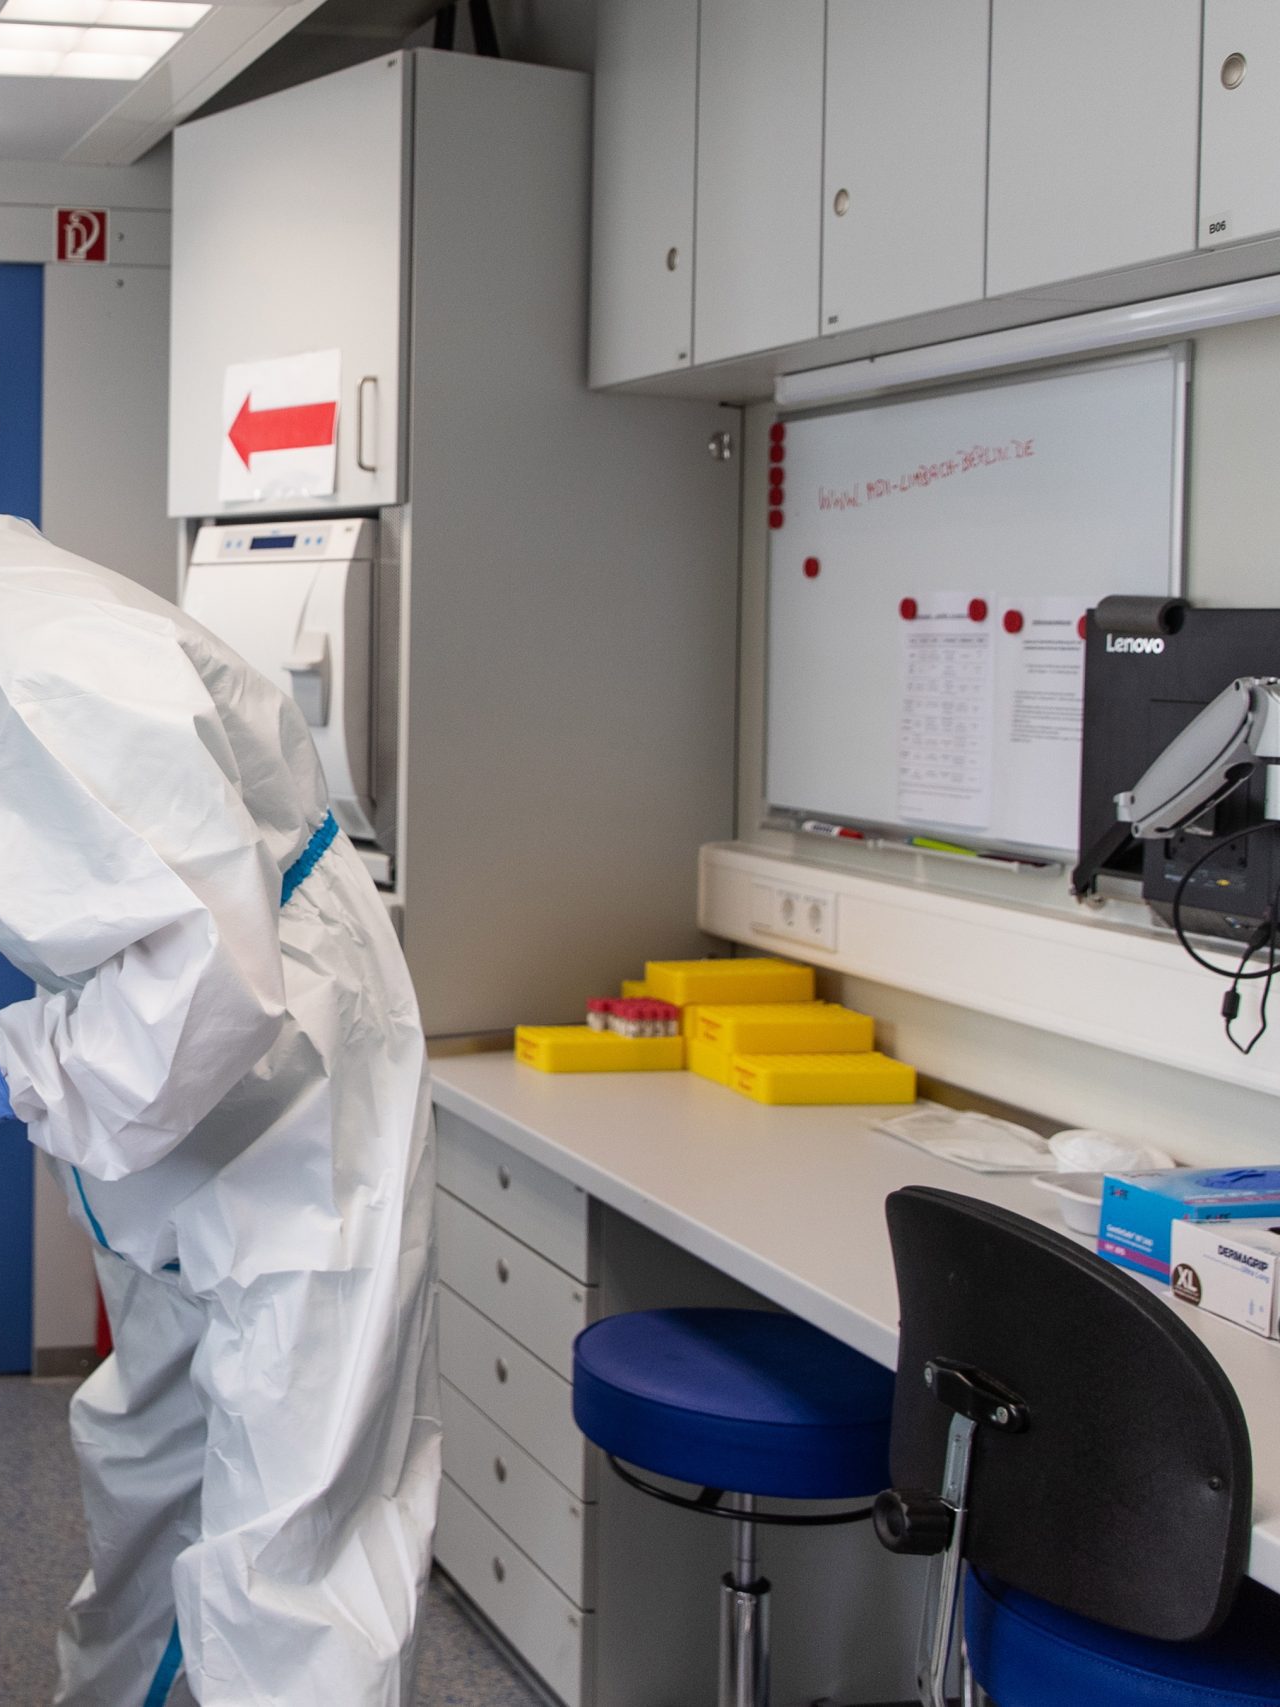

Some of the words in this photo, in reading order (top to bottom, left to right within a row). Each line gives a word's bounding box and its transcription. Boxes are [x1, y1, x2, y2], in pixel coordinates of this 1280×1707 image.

[1209, 220, 1227, 234] B06
[1106, 633, 1165, 654] Lenovo
[1218, 1245, 1269, 1271] DERMAGRIP
[1176, 1265, 1198, 1292] XL
